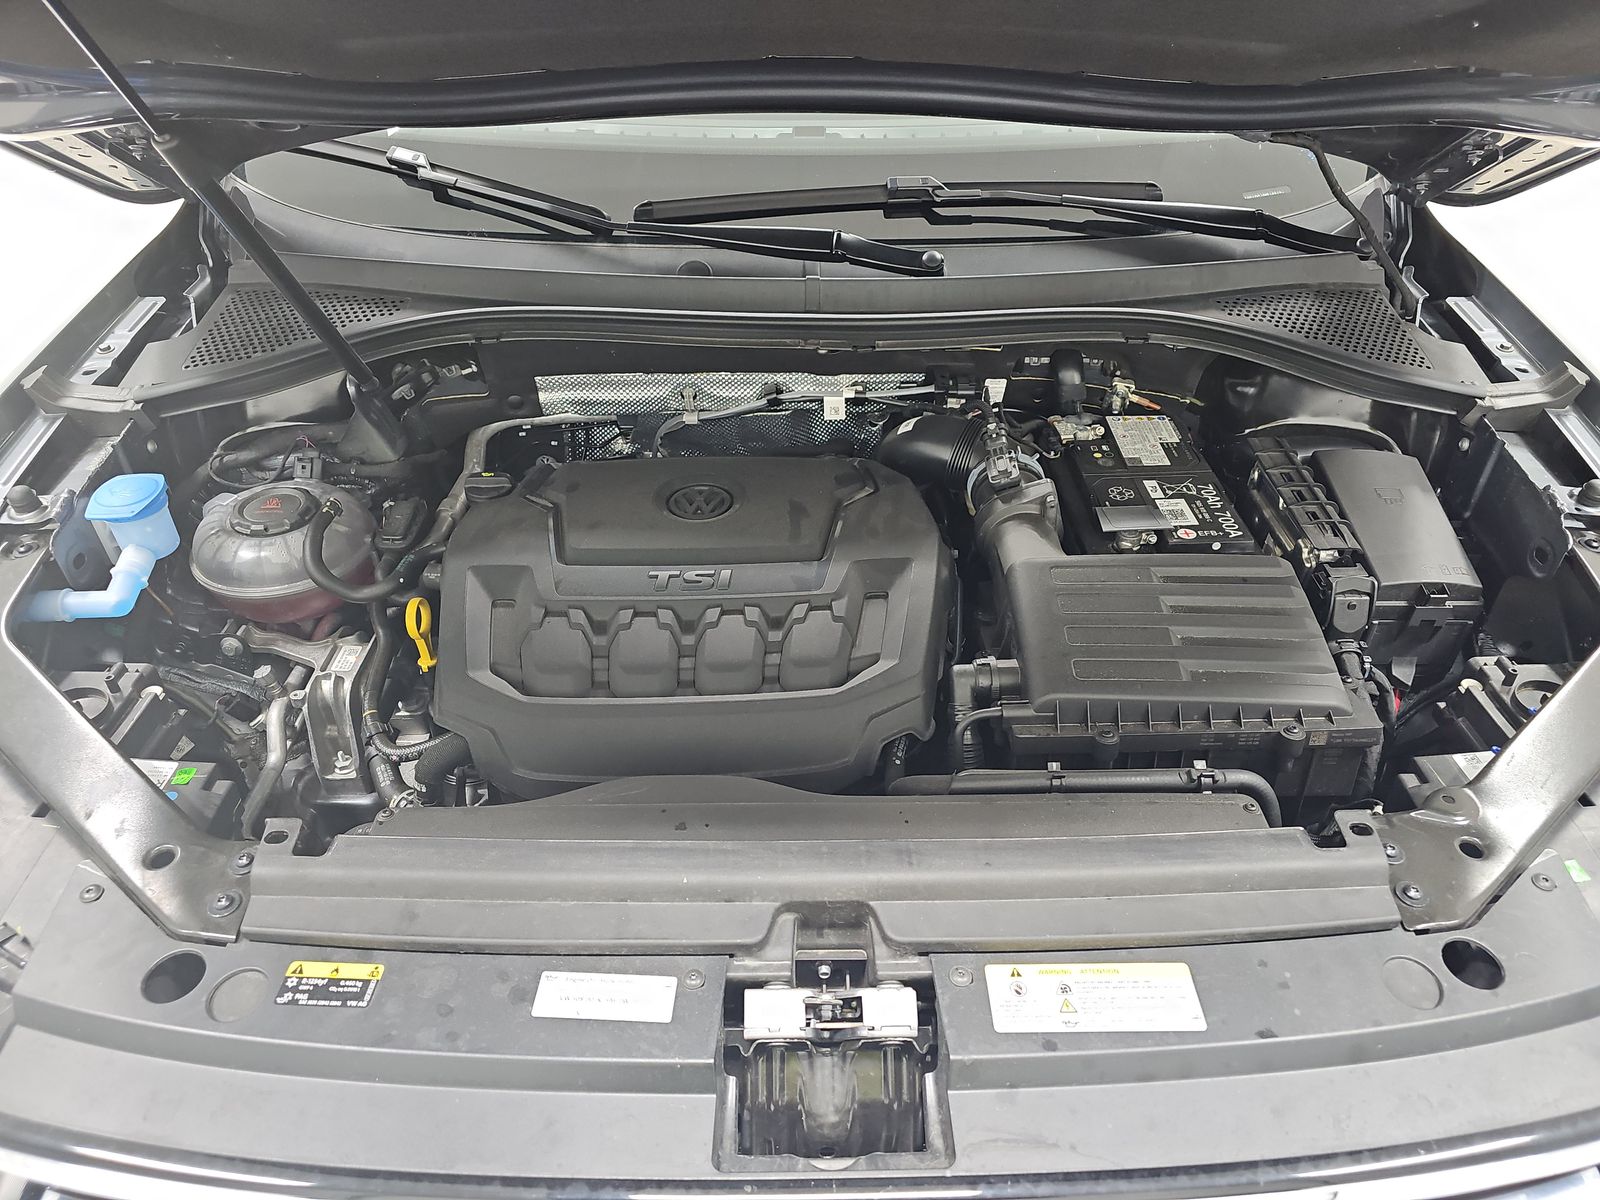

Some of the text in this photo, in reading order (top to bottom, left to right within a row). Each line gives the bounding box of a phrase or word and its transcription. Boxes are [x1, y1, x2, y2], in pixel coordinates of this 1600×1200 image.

[1197, 483, 1224, 509] 70Ah
[1214, 511, 1244, 538] 700A
[648, 569, 733, 592] TSI
